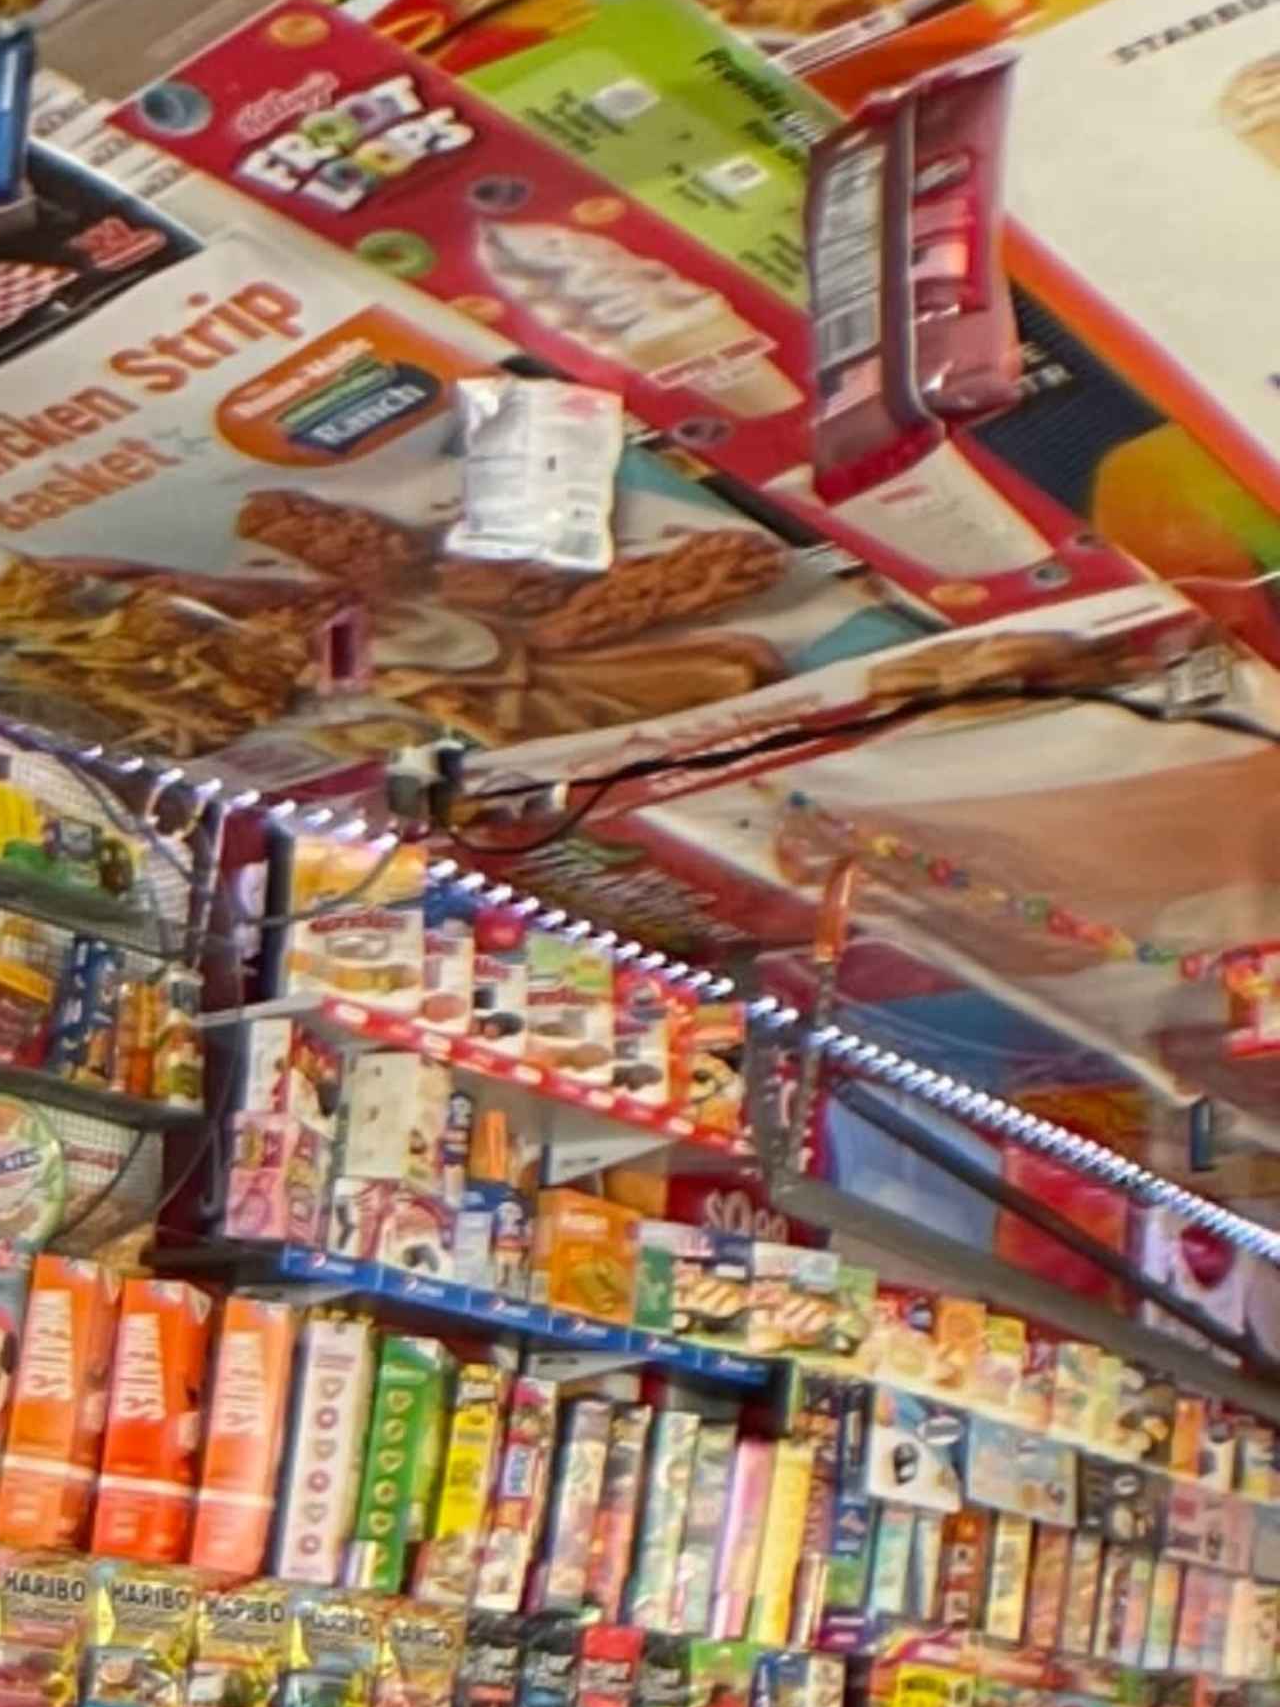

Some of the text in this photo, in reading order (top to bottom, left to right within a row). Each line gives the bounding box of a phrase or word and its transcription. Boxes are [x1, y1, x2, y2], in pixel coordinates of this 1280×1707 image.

[238, 76, 424, 188] FROOT
[277, 105, 477, 212] LOOPS
[109, 278, 309, 396] Strip
[312, 372, 426, 450] Ranch
[4, 1571, 87, 1603] HARIBO
